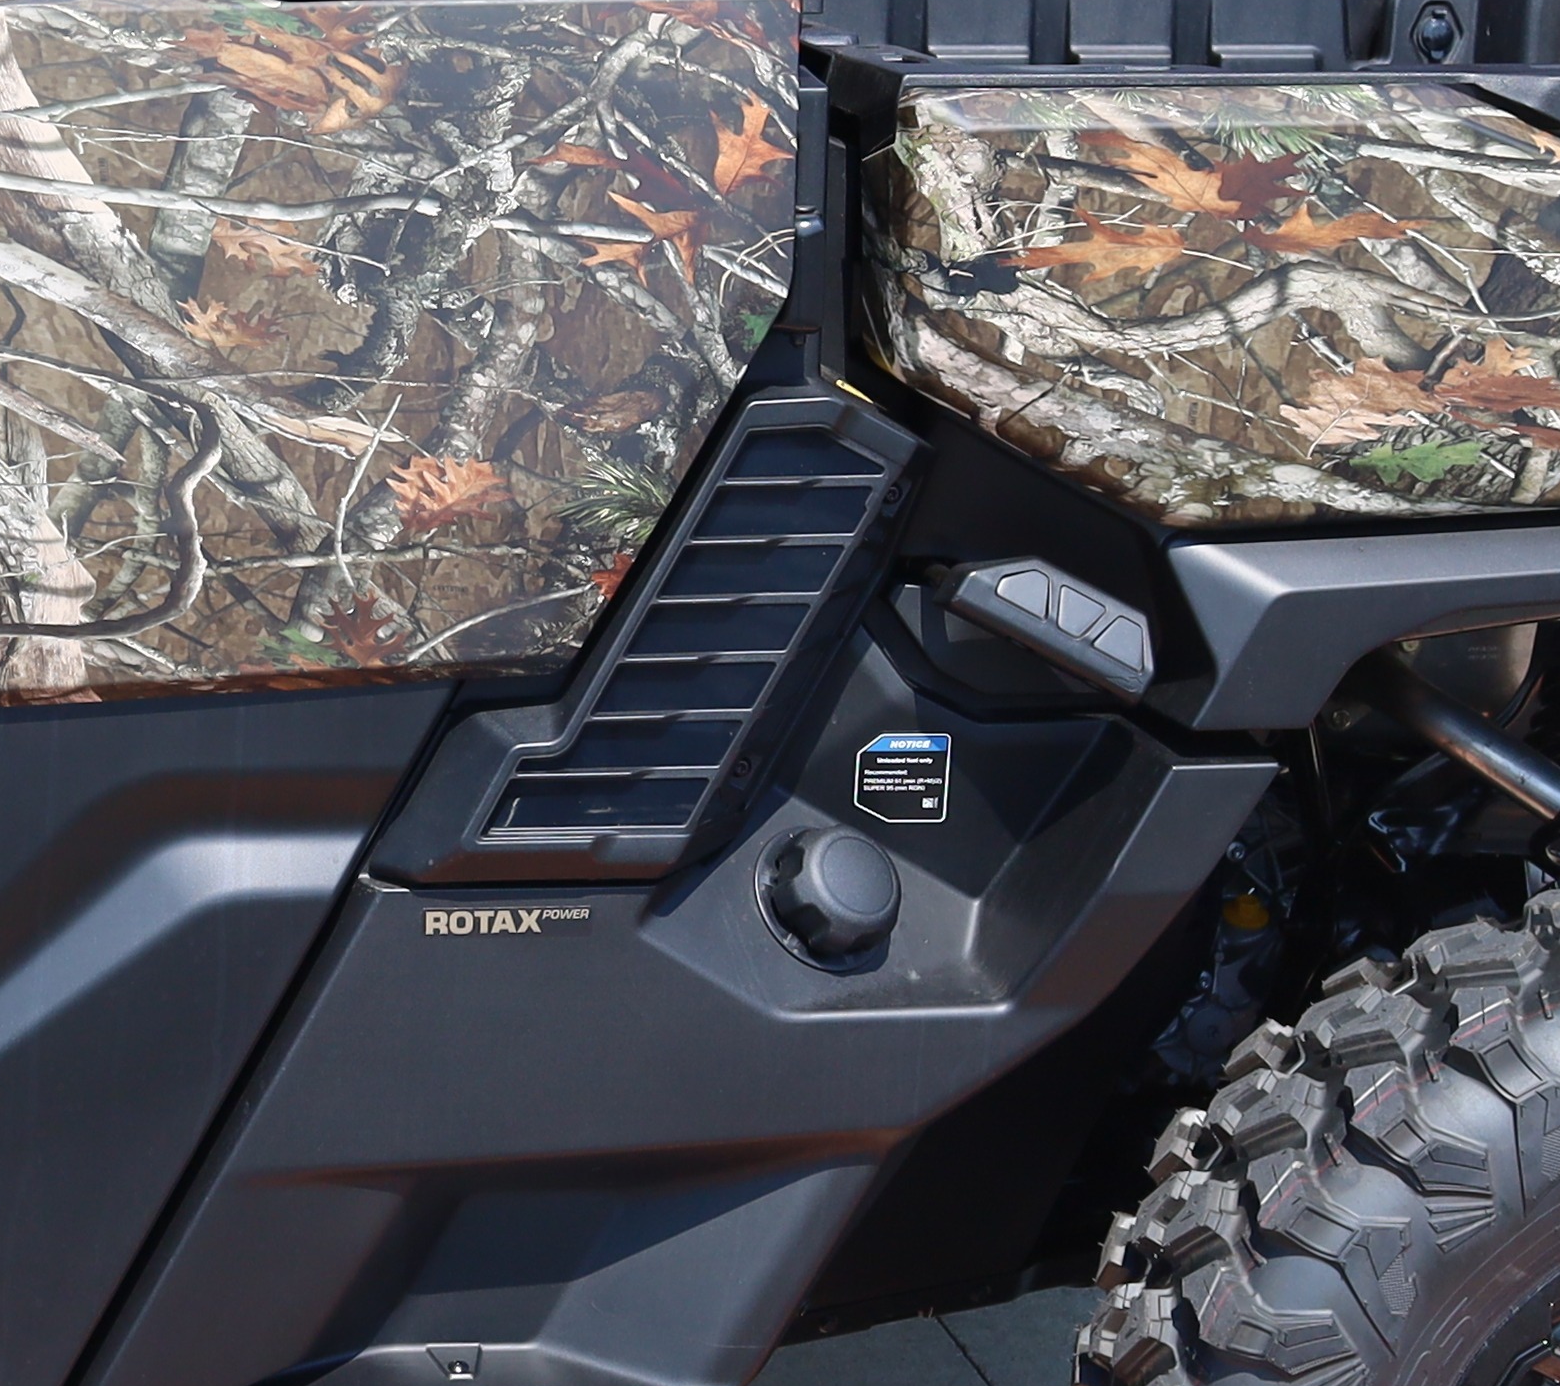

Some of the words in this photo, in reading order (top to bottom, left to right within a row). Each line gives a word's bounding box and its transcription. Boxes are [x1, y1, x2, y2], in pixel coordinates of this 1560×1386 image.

[889, 740, 931, 749] NOTICE
[425, 910, 542, 935] ROTAX
[542, 909, 589, 920] POWER
